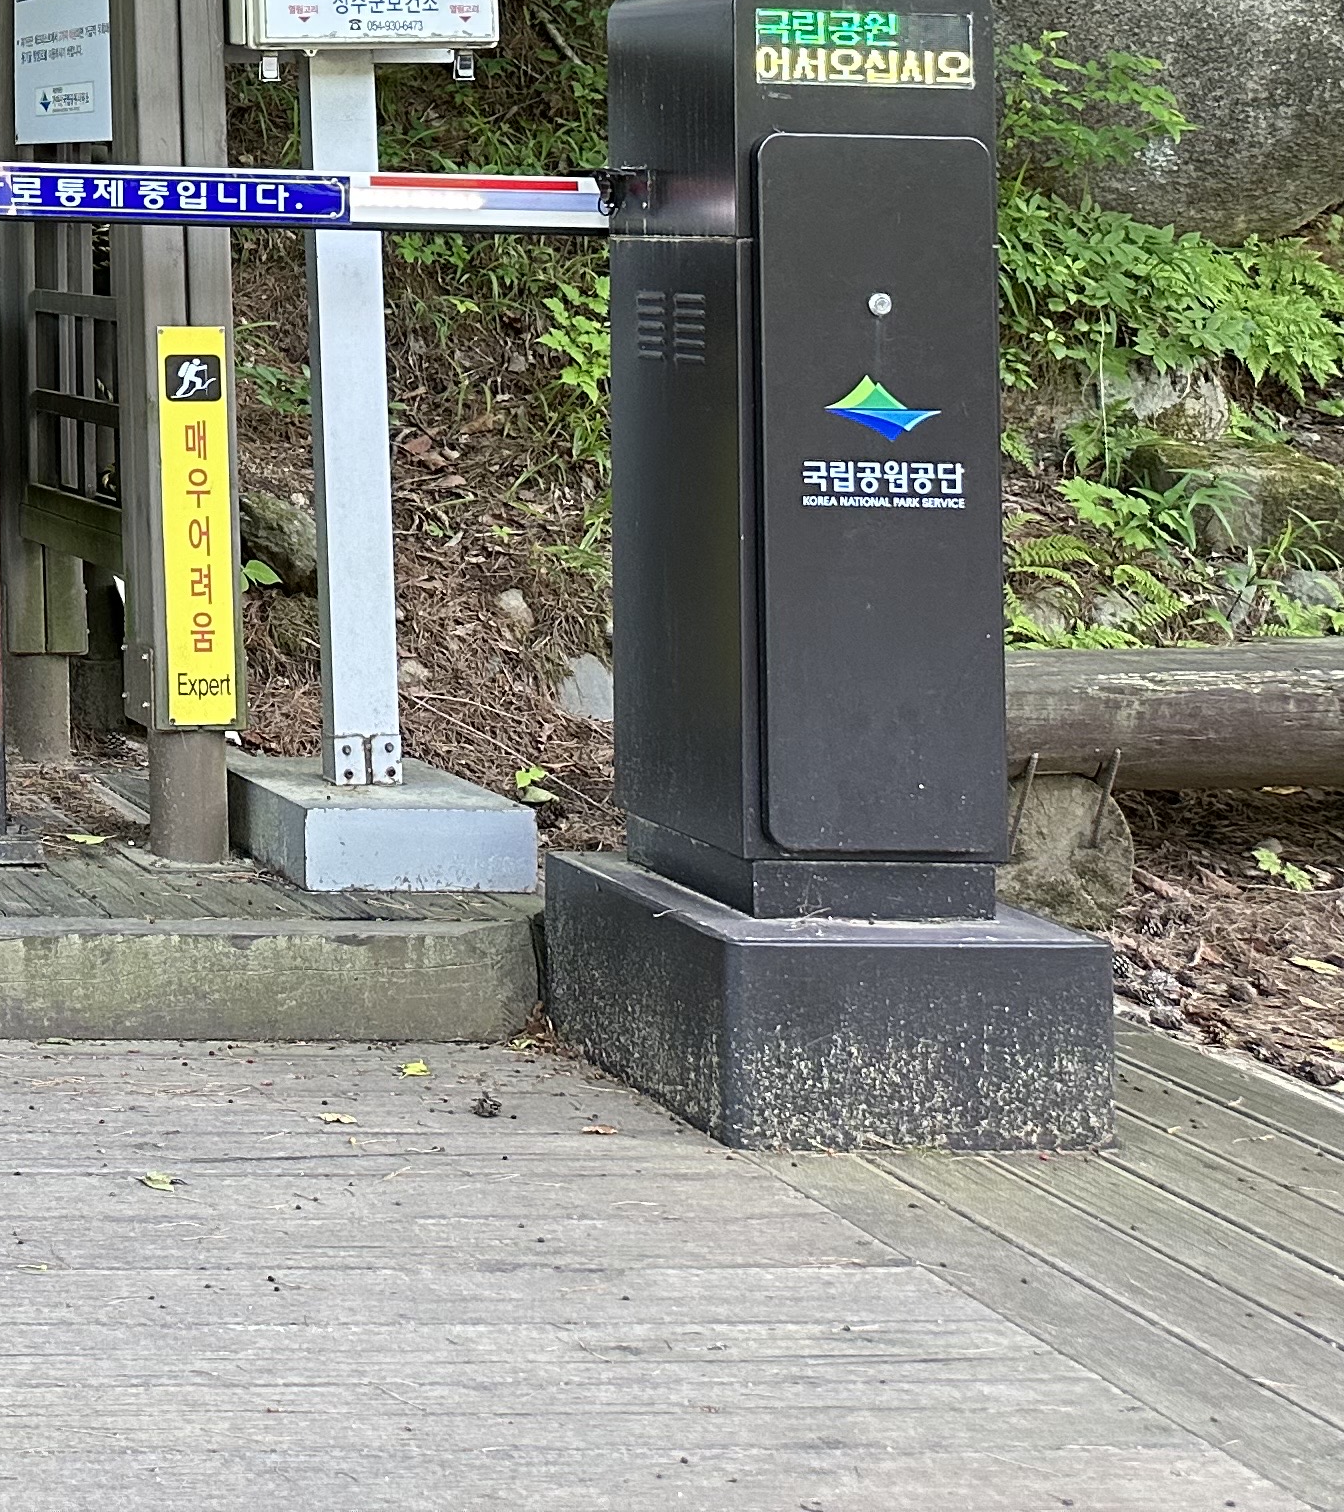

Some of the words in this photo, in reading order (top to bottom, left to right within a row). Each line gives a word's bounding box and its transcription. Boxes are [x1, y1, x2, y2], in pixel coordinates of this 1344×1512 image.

[367, 21, 423, 31] 054-930-6473
[757, 9, 899, 47] 국립공원
[757, 46, 972, 84] 어서오십시오
[55, 179, 124, 208] 통제
[802, 459, 965, 494] 국립공원공단
[802, 494, 837, 507] KOREA
[840, 495, 890, 508] NATIONAL
[893, 495, 920, 508] PARK
[922, 496, 965, 509] SERVICE
[178, 672, 231, 700] Expert
